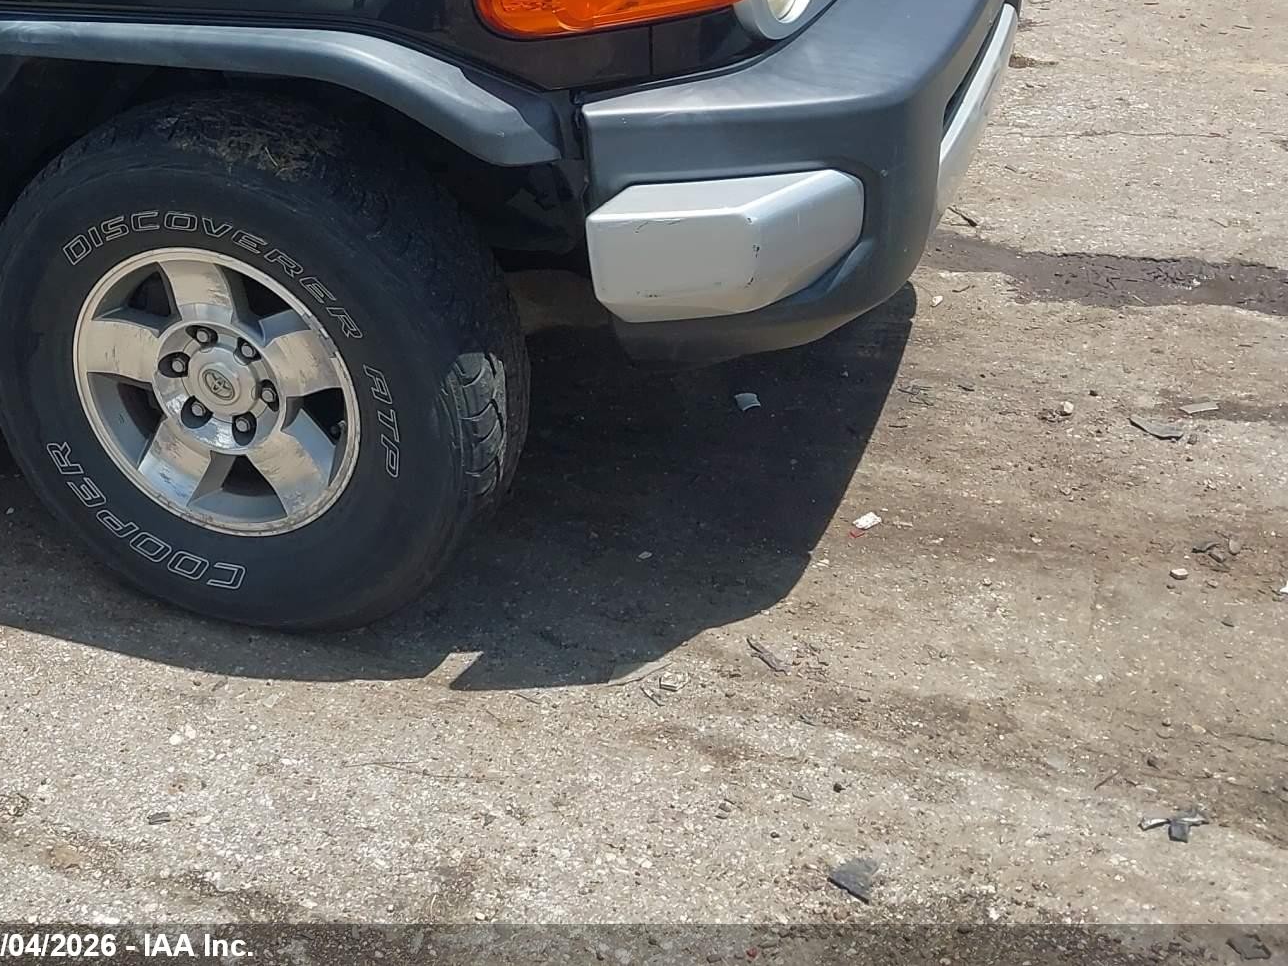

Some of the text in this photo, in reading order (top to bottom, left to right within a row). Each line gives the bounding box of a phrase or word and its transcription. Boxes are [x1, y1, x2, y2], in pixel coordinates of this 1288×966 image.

[62, 210, 401, 478] DISCOVERER ATP
[46, 441, 246, 590] COOPER
